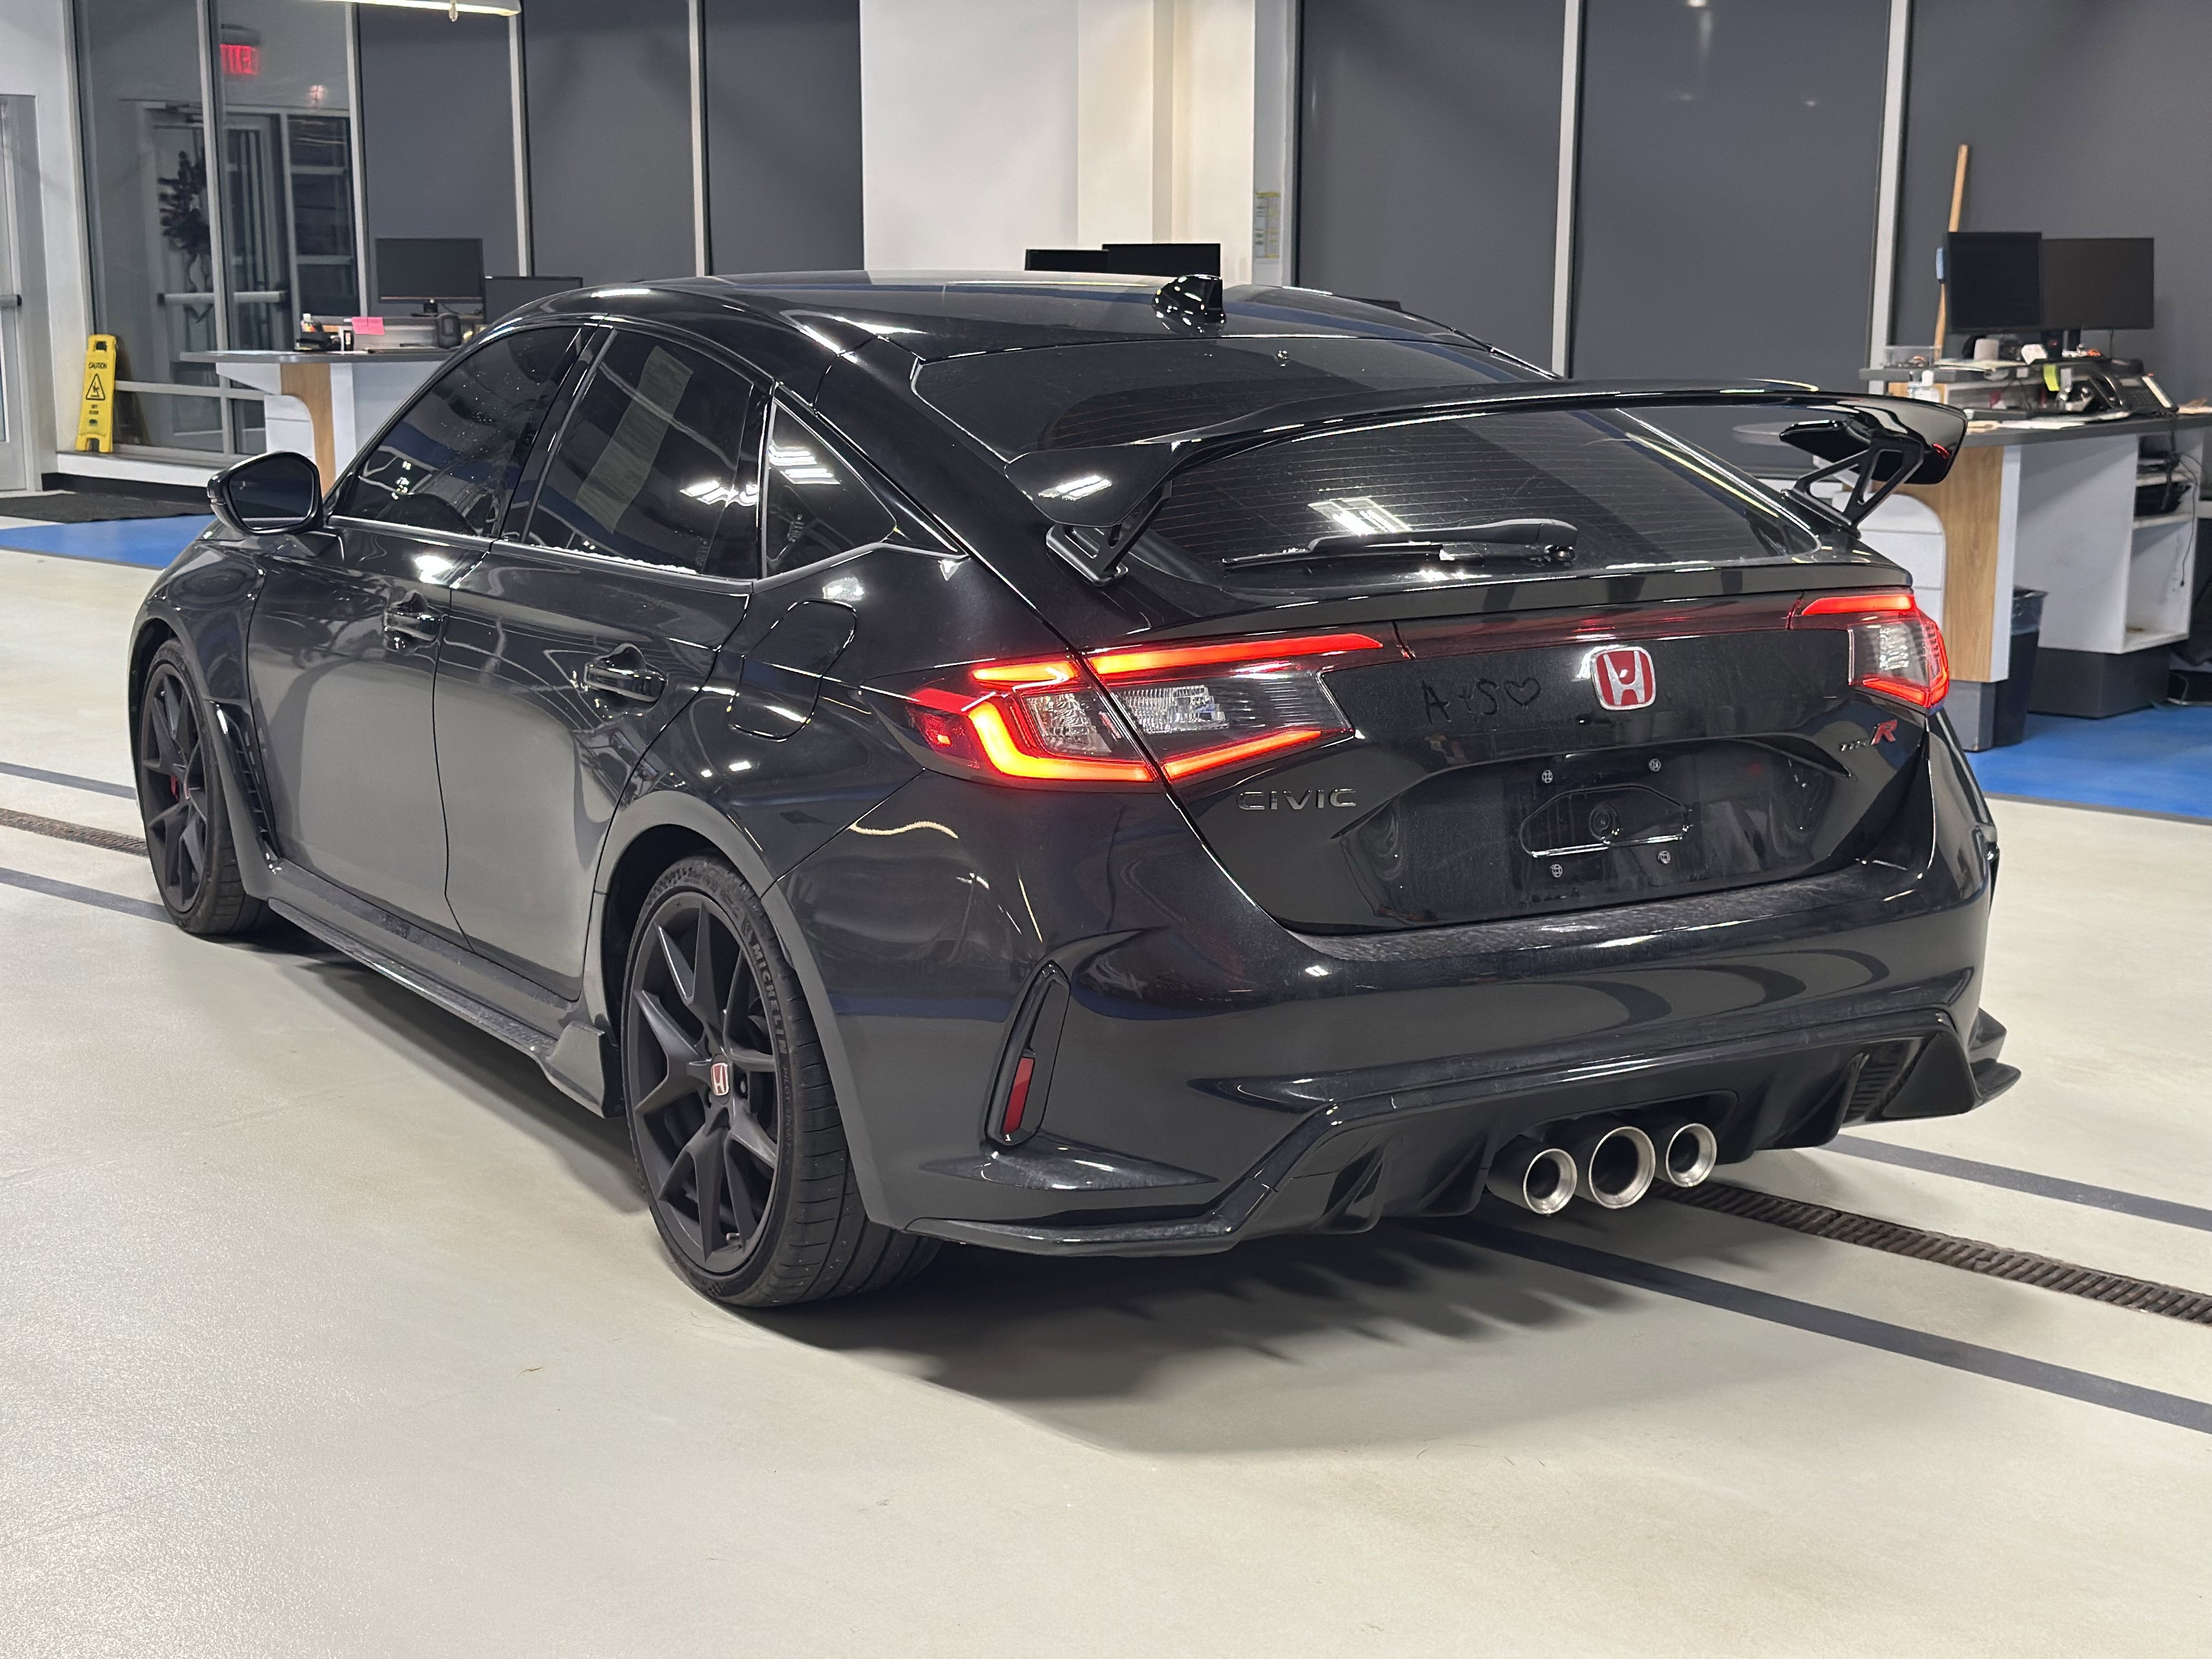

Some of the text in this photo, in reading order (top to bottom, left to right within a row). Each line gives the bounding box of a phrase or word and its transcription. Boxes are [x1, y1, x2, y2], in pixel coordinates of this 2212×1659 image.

[1871, 719, 1898, 745] R
[1237, 788, 1357, 810] CIVIC
[751, 943, 788, 1054] MICHELIN
